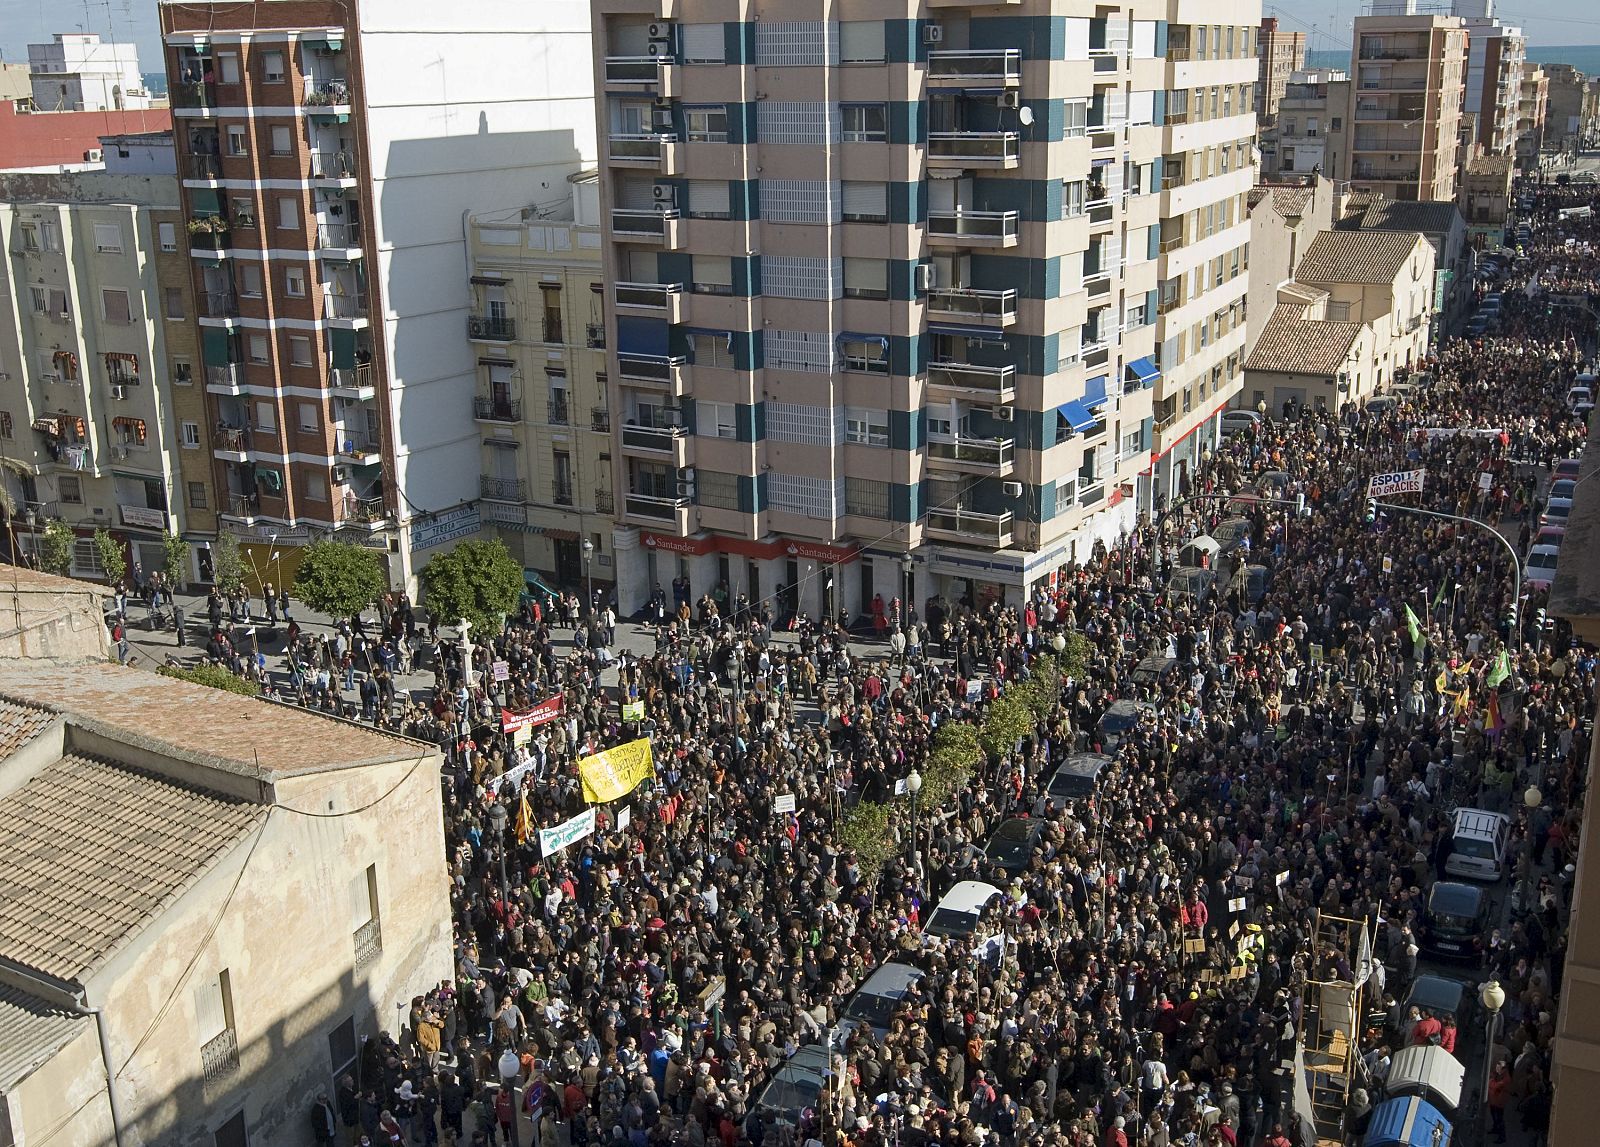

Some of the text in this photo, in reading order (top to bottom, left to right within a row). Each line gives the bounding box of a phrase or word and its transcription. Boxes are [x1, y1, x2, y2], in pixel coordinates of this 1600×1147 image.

[1370, 486, 1382, 497] NO
[656, 538, 696, 553] Santander
[799, 545, 842, 561] Santander
